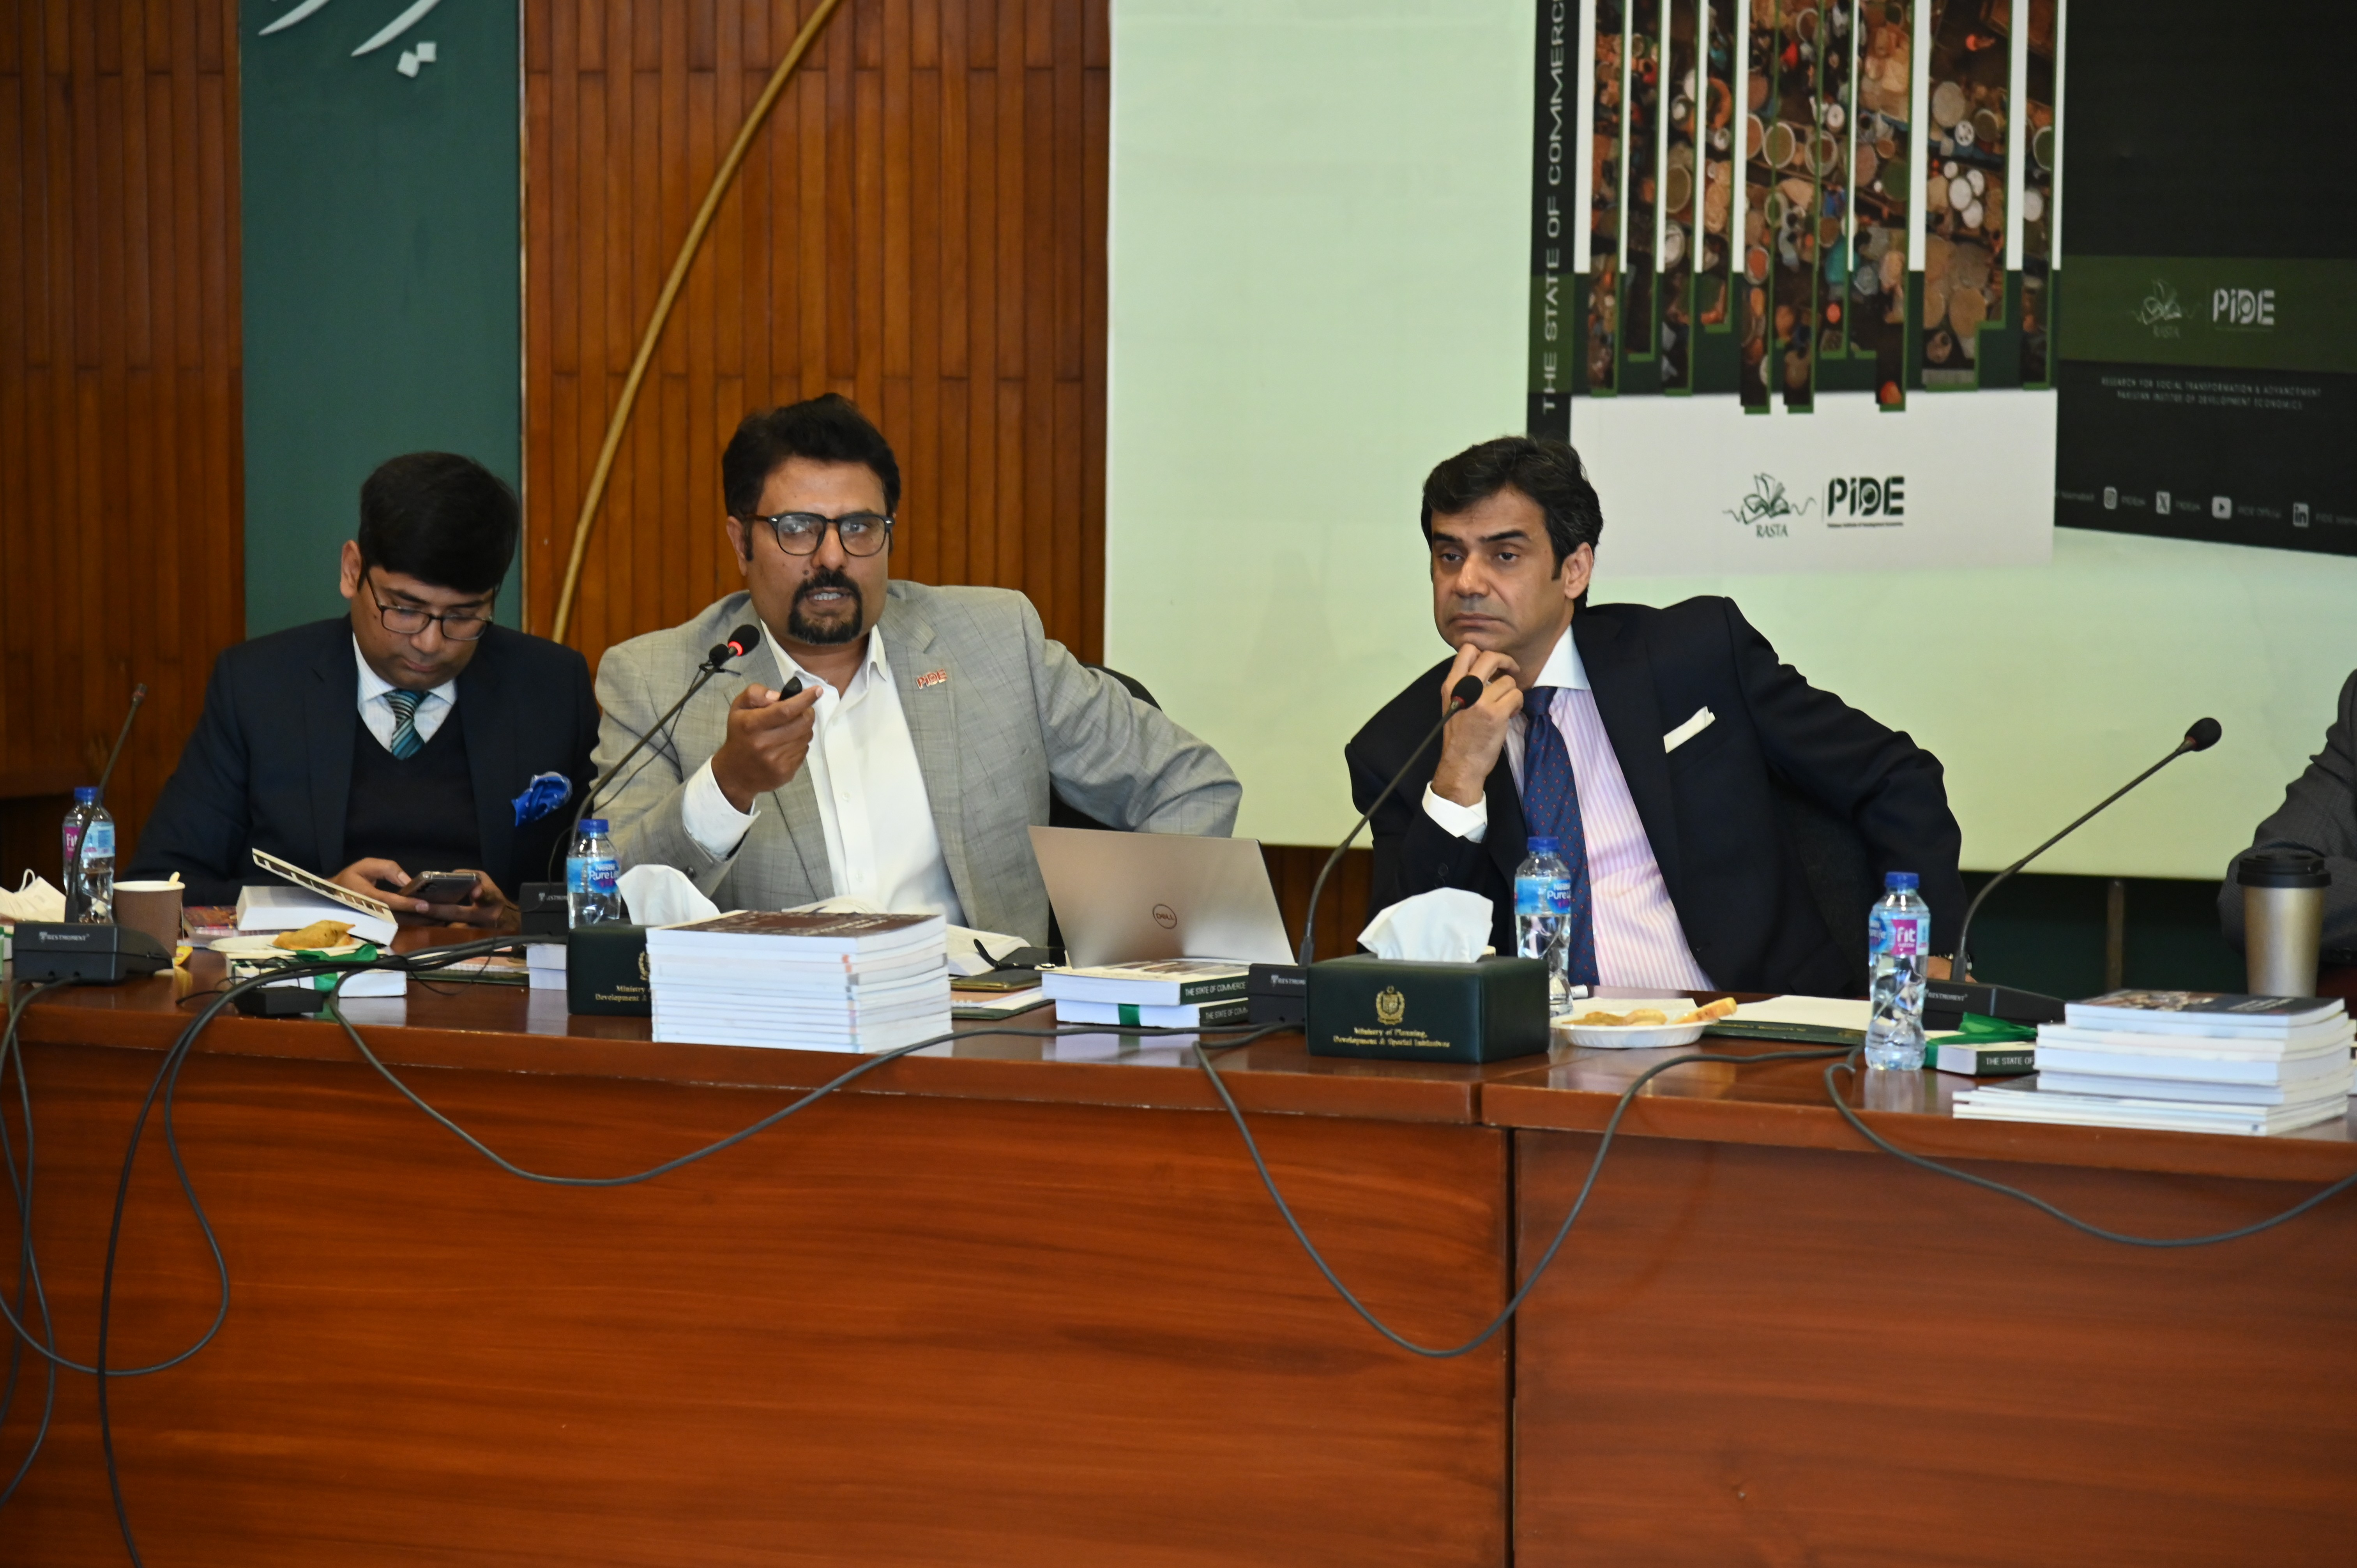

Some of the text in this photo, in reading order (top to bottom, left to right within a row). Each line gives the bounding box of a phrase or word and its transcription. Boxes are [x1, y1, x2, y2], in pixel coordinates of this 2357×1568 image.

[1542, 0, 1565, 415] THE STATE OF COMMERC
[1756, 523, 1788, 539] RASTA
[1185, 981, 1247, 996] THE STATE OF COMMERCE
[1215, 1010, 1227, 1019] STATE
[1228, 1008, 1233, 1017] OF
[1986, 1056, 2034, 1065] THE STATE OF
